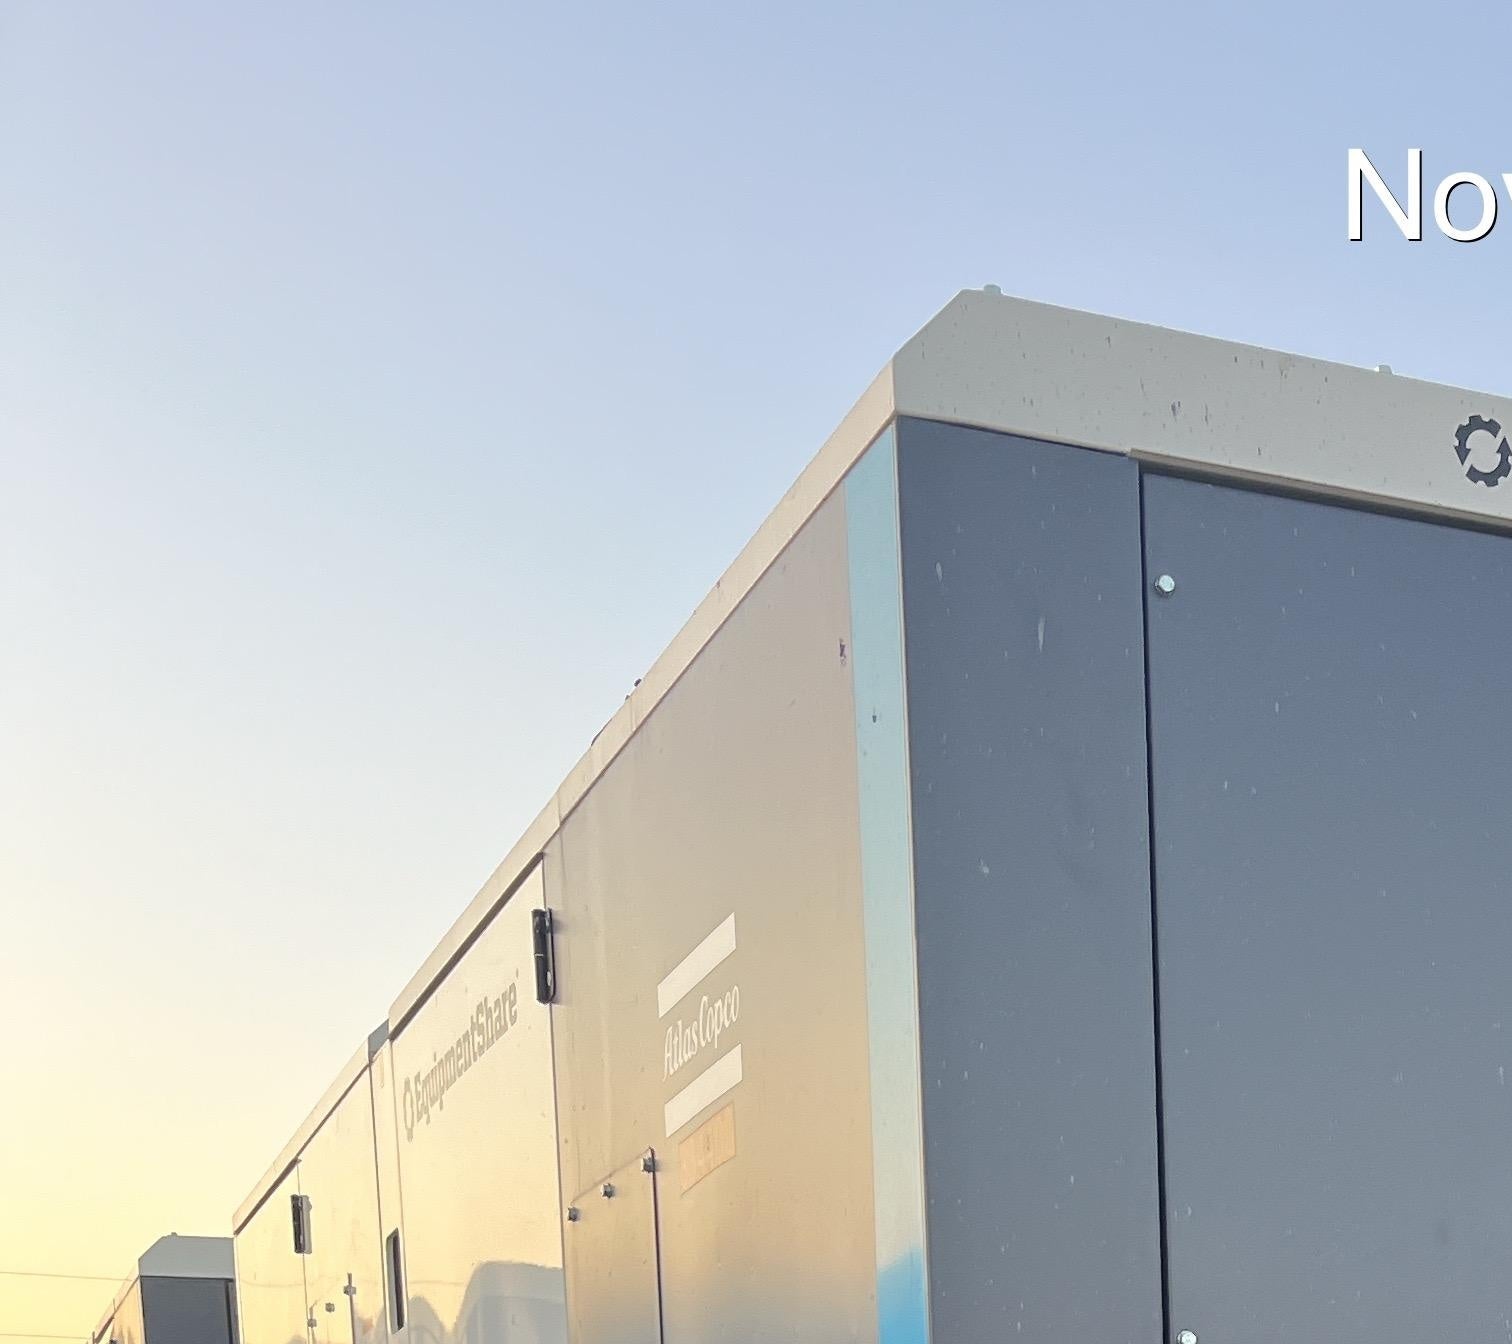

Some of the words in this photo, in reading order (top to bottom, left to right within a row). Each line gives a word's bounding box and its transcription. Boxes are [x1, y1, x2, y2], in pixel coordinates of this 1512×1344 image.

[415, 982, 518, 1126] EquipmentShare
[662, 1021, 699, 1083] Atlas
[699, 985, 740, 1050] Copco
